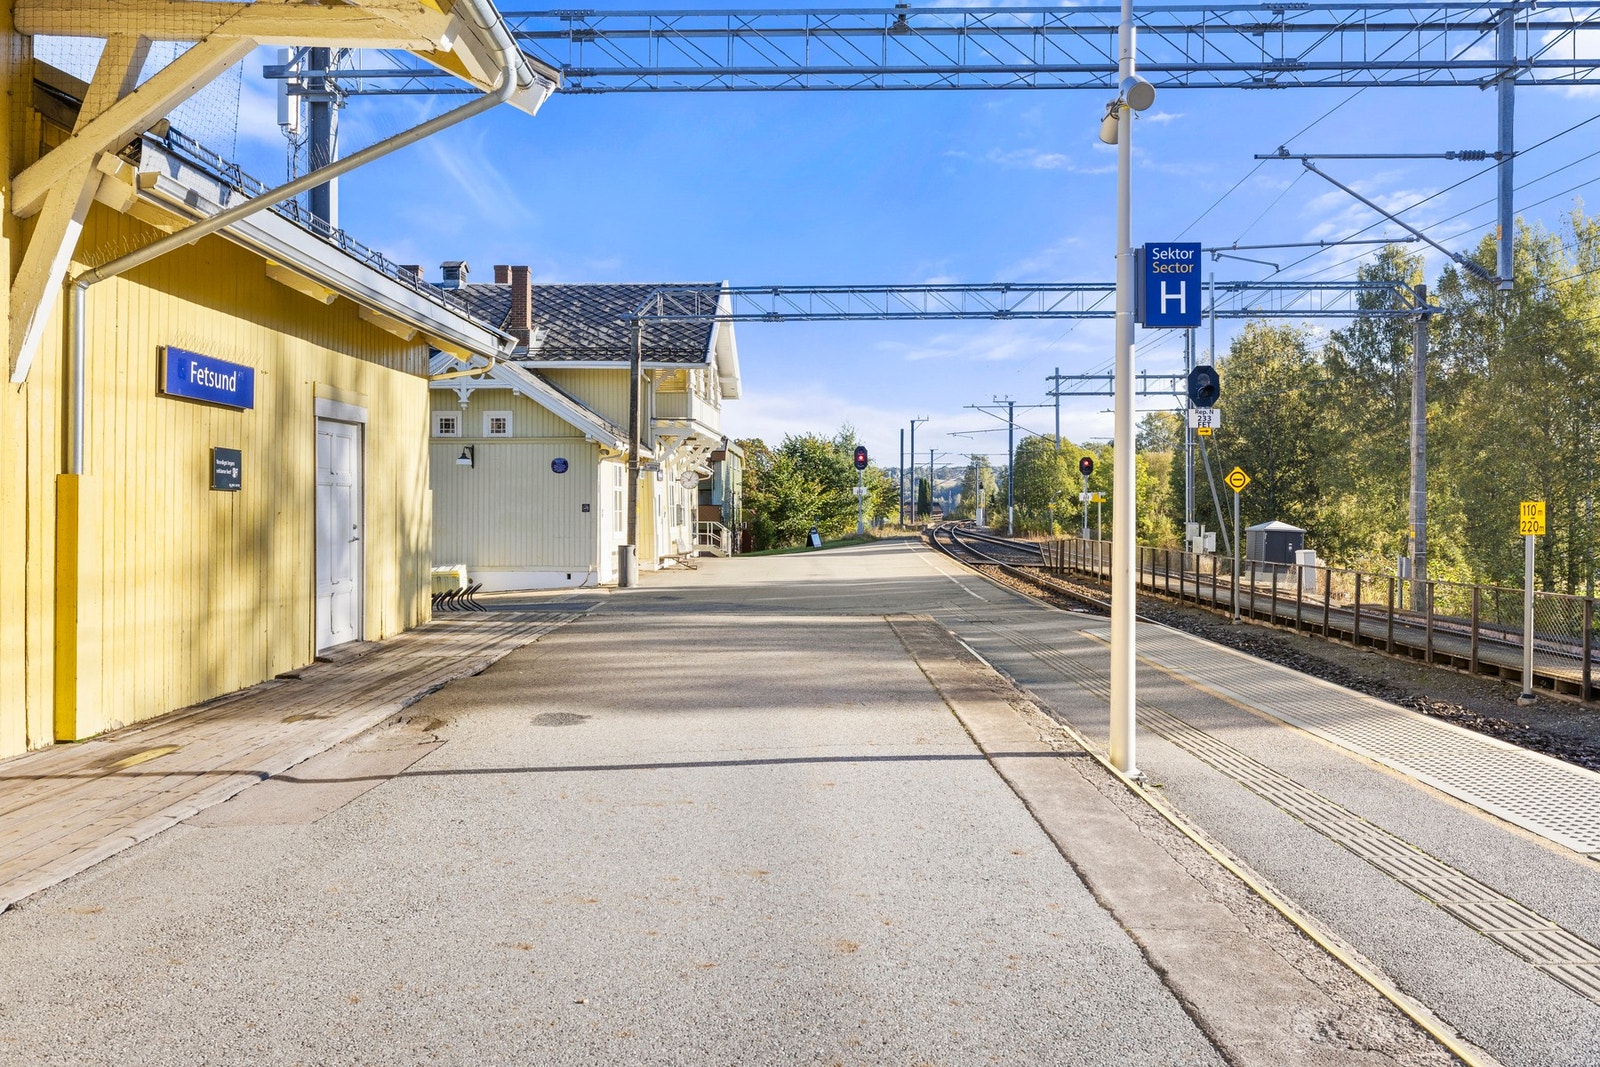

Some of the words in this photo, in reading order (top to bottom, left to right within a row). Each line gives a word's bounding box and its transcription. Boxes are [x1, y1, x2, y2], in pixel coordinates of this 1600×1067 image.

[1152, 247, 1194, 260] Sektor
[1152, 261, 1194, 274] Sector
[1160, 280, 1186, 314] H
[190, 360, 237, 392] Fetsund
